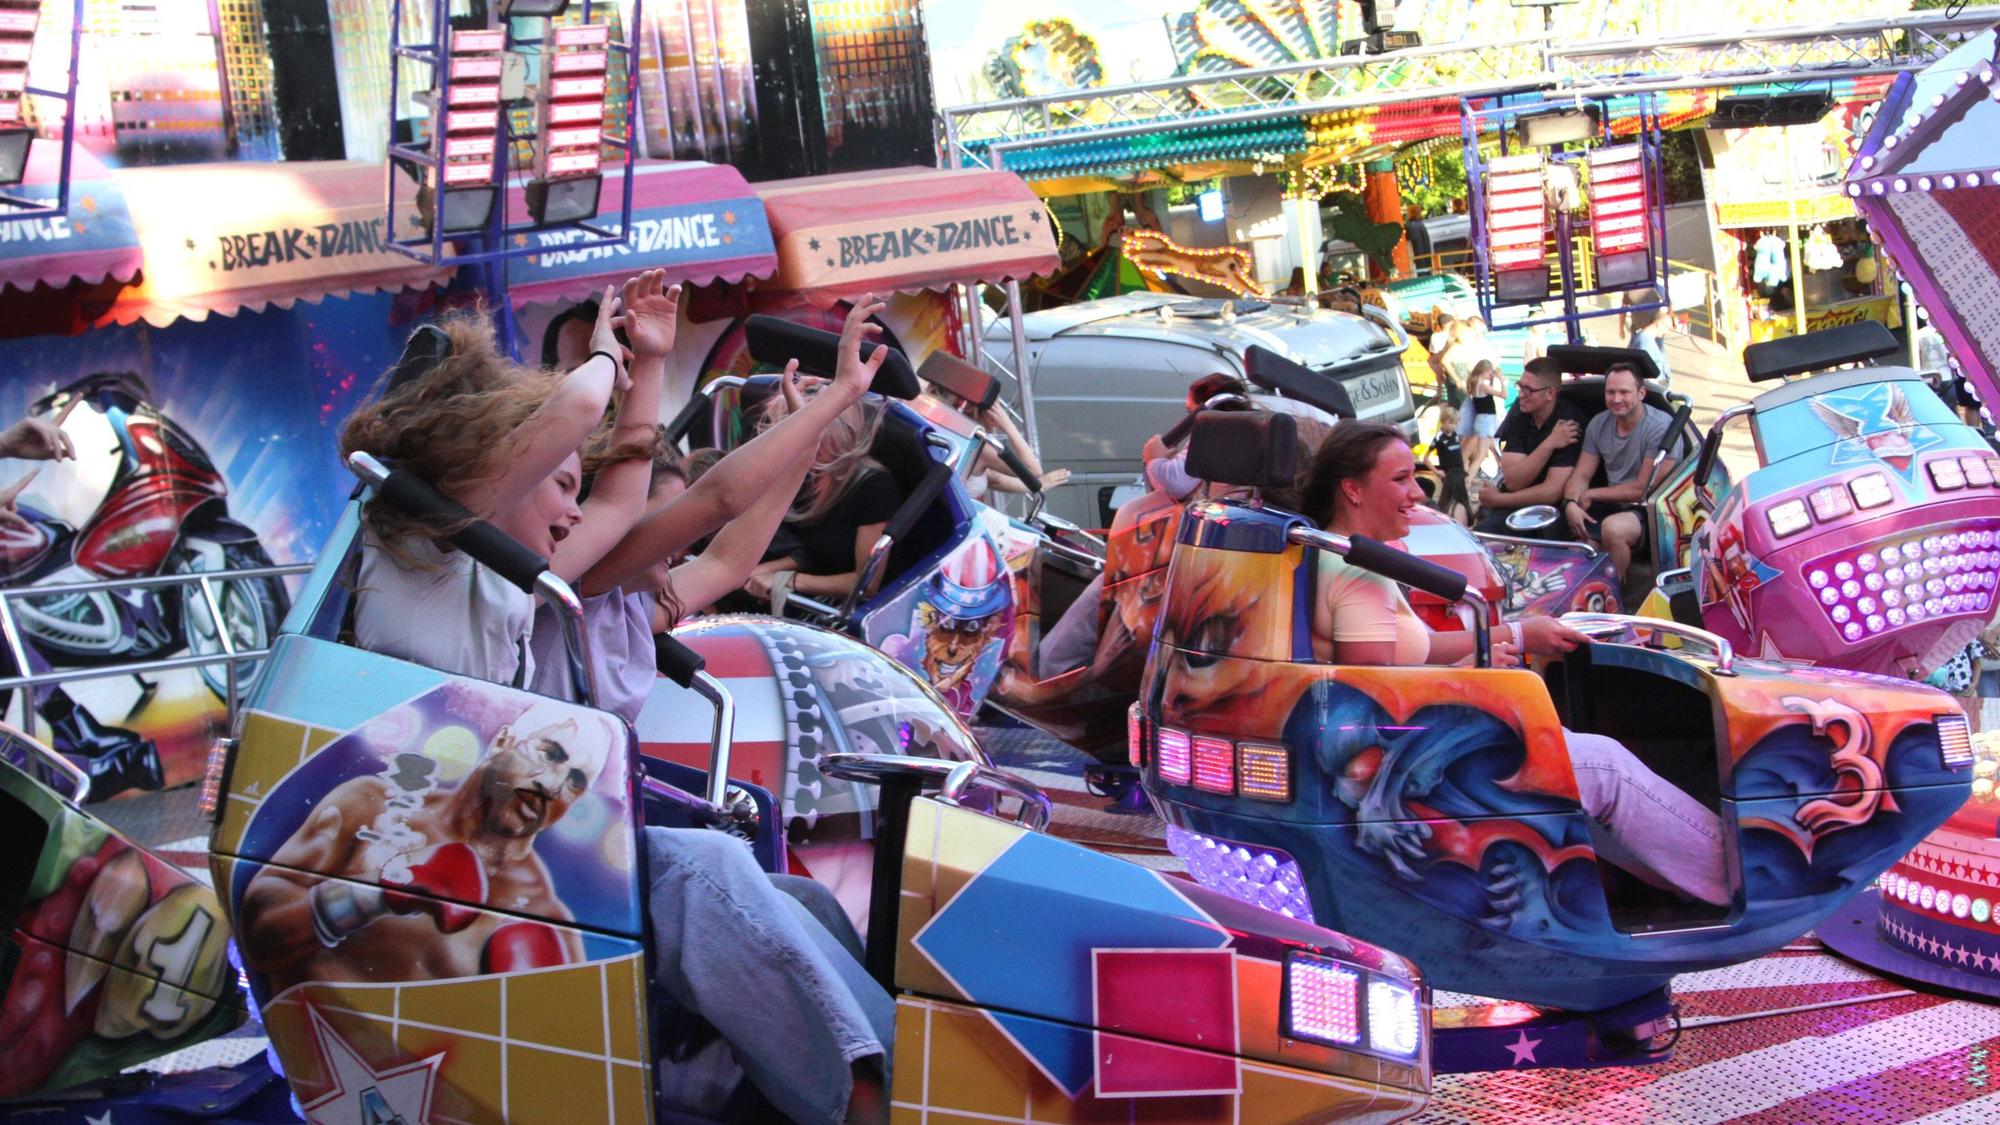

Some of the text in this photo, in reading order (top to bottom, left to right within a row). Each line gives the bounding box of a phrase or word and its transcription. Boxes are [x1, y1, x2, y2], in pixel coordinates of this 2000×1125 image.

[219, 217, 389, 271] BREAK DANC
[631, 213, 720, 253] DANCE
[837, 214, 1019, 268] BREAK DANCE
[1781, 696, 1882, 834] 3
[139, 904, 214, 1028] 1
